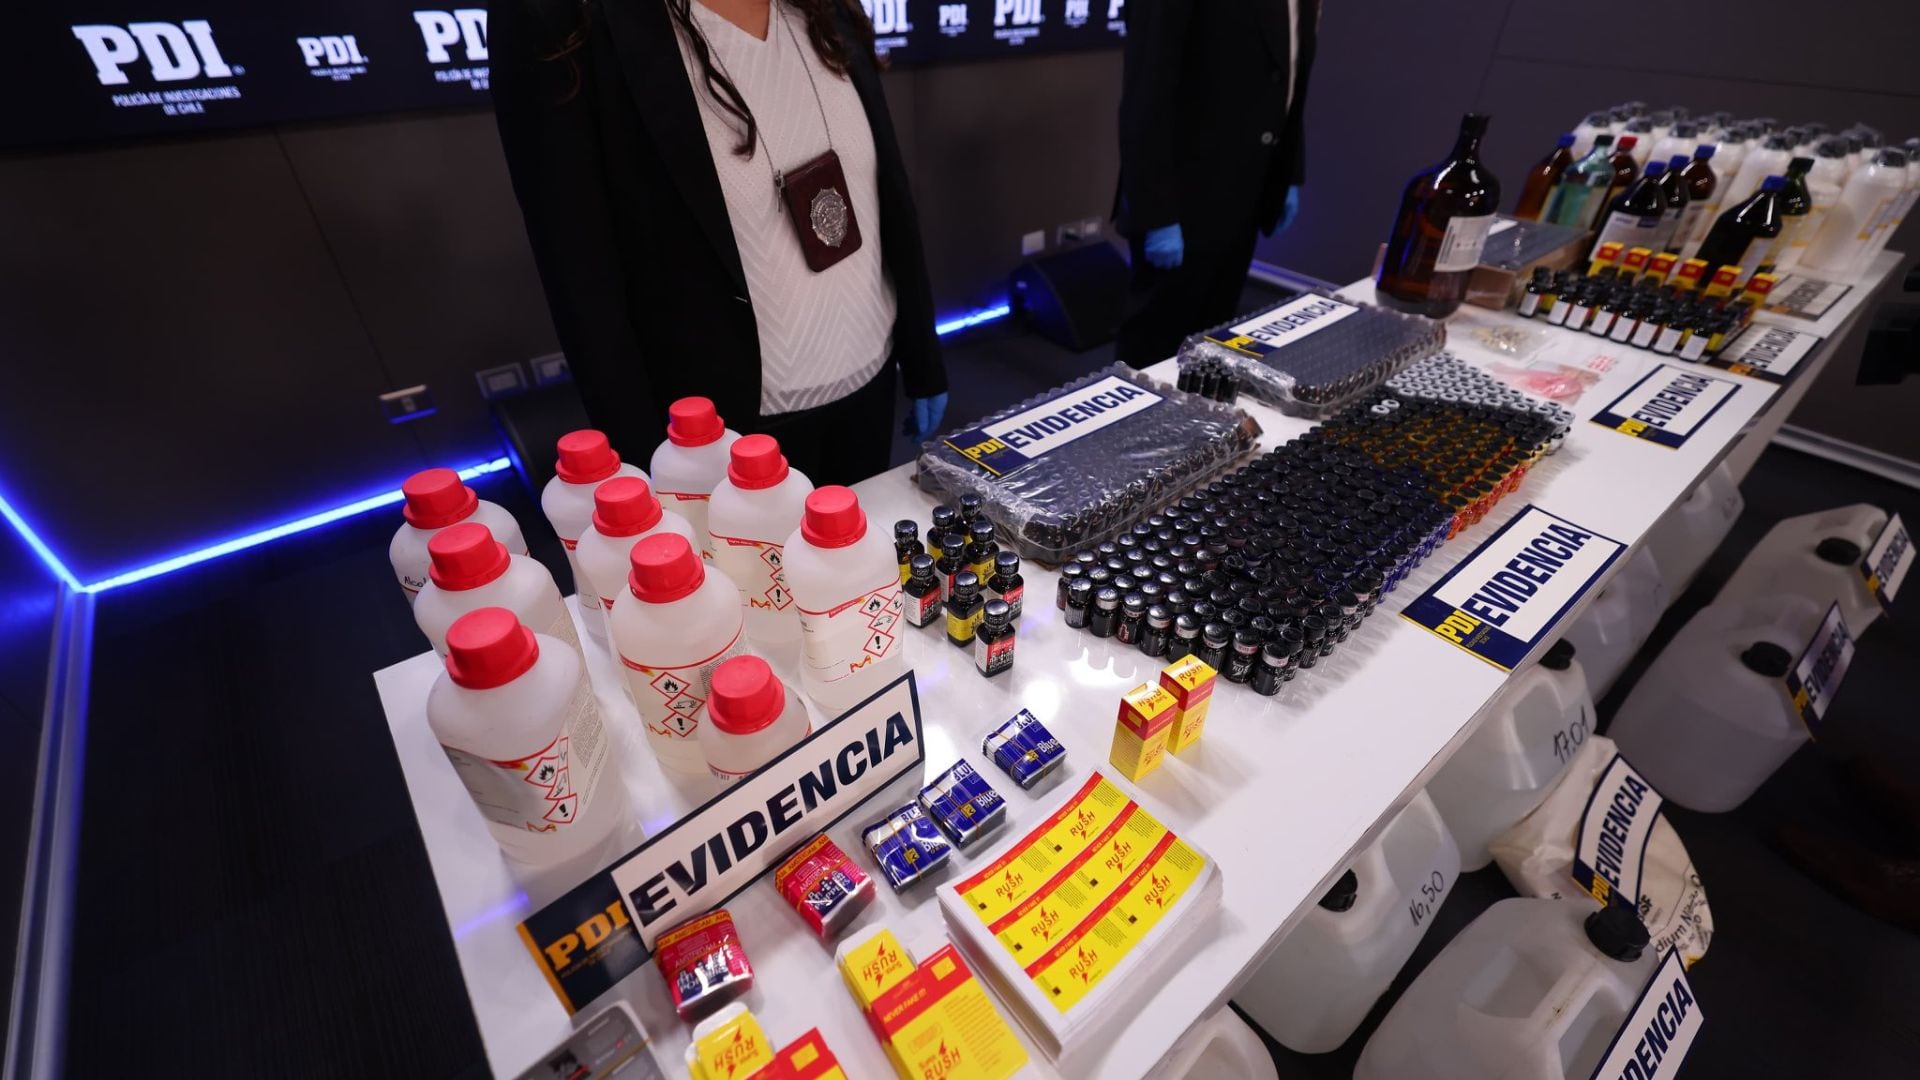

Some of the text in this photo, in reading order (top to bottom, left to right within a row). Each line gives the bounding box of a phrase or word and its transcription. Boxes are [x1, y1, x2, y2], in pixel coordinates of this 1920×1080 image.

[939, 5, 967, 27] PDI
[72, 20, 233, 85] PDI
[297, 35, 363, 66] PDI
[413, 9, 488, 63] PD
[112, 86, 241, 107] POLICÍA DE INVESTIGACIONES
[163, 101, 206, 116] DE CHILE
[1246, 300, 1343, 342] EVIDENCIA
[1631, 373, 1714, 428] EVIDENCIA
[998, 385, 1145, 450] EVIDENCIA
[964, 438, 1005, 459] PDI
[1460, 523, 1593, 628] EVIDENCIA
[1434, 608, 1482, 643] PDI
[629, 711, 913, 928] EVIDENCIA
[1069, 811, 1096, 837] RUSH
[1595, 775, 1649, 889] EVIDENCIA
[1105, 842, 1132, 870] RUSH
[995, 873, 1024, 899] RUSH
[1144, 876, 1171, 905] RUSH
[1408, 870, 1444, 926] 16,50
[545, 900, 630, 971] PDI
[1030, 910, 1060, 937] RUSH
[1655, 925, 1688, 953] dium
[862, 950, 897, 981] RUSH
[1068, 949, 1098, 979] RUSH
[1618, 978, 1693, 1080] DENCIA
[714, 1035, 755, 1073] RUSH
[923, 1047, 961, 1080] RUSH
